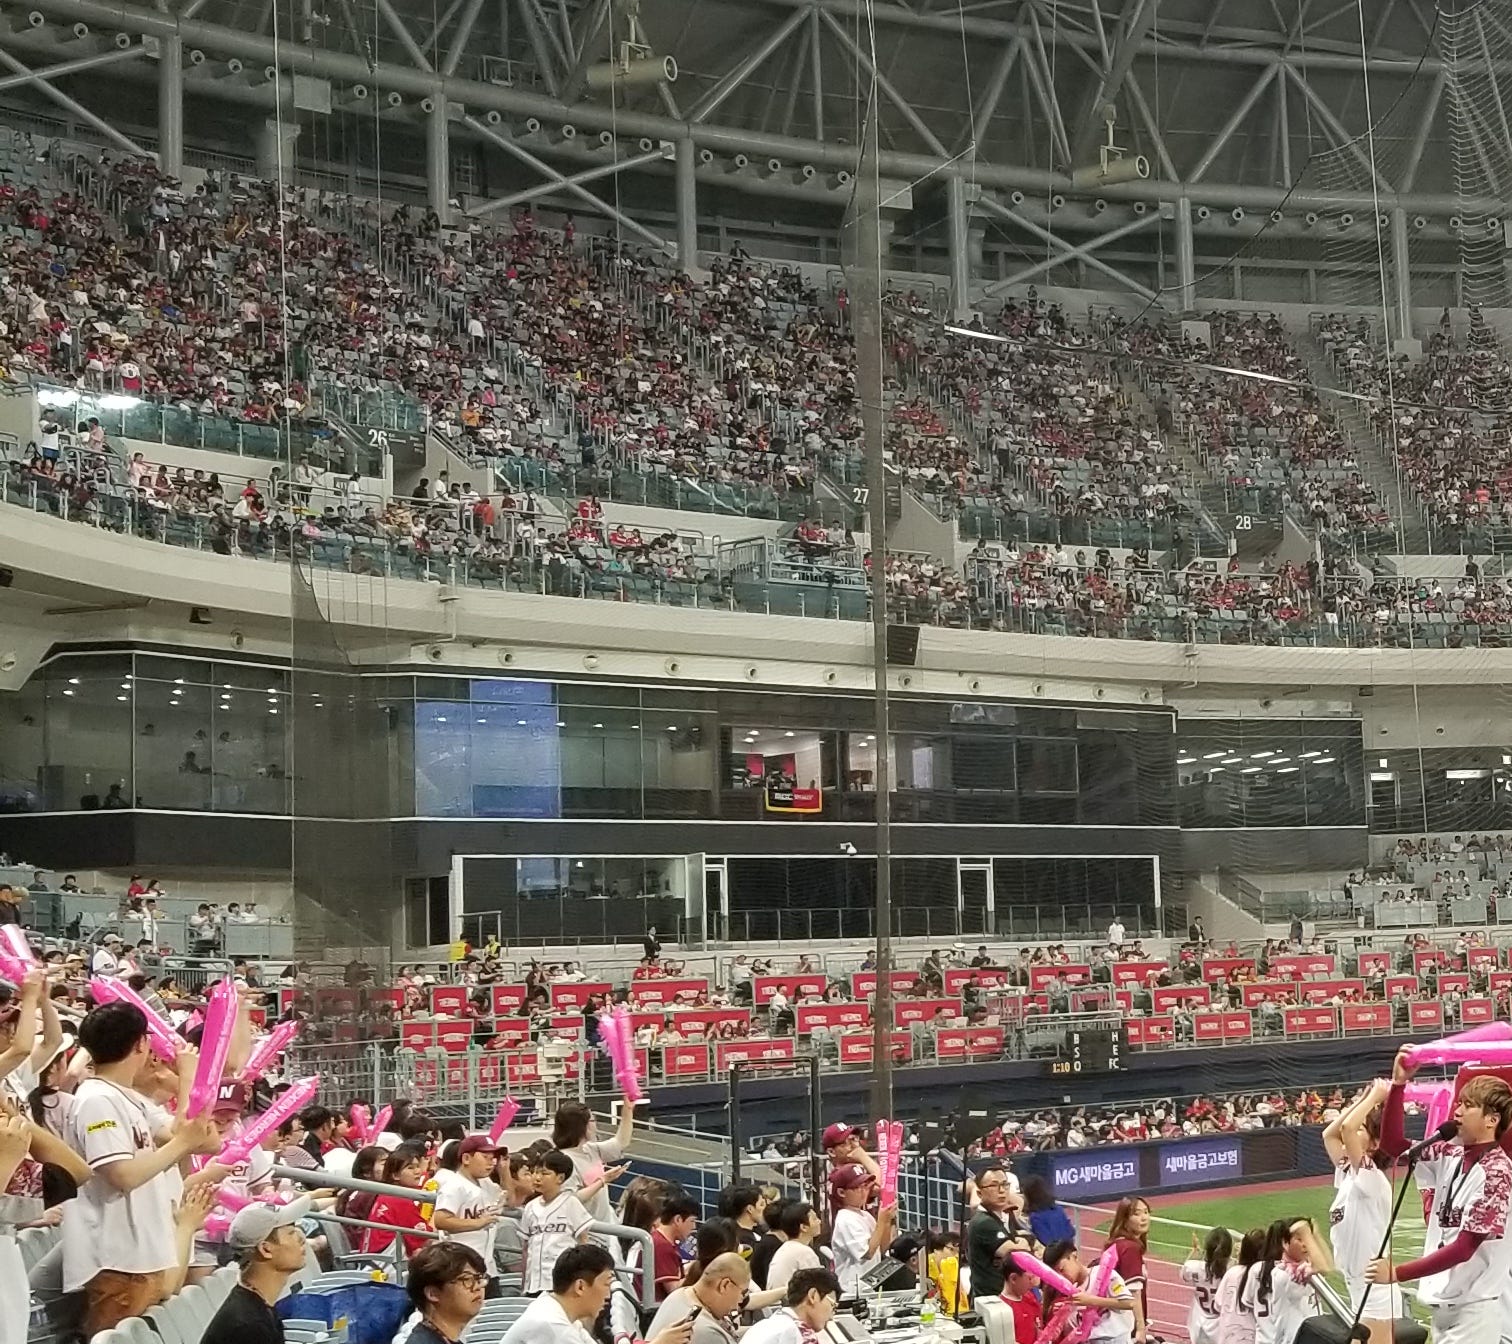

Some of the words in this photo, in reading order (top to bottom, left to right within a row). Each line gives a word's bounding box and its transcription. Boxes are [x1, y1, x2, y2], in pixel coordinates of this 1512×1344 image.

[368, 429, 387, 446] 26
[853, 487, 870, 505] 27
[1236, 515, 1251, 530] 28
[1111, 1031, 1119, 1042] H
[1074, 1046, 1081, 1059] S
[1112, 1044, 1119, 1056] E
[1052, 1061, 1071, 1074] 1:10
[1073, 1060, 1082, 1072] O
[219, 1084, 236, 1099] N
[1165, 1150, 1238, 1173] 새마을금고보험
[1055, 1162, 1136, 1186] MG새마을금고
